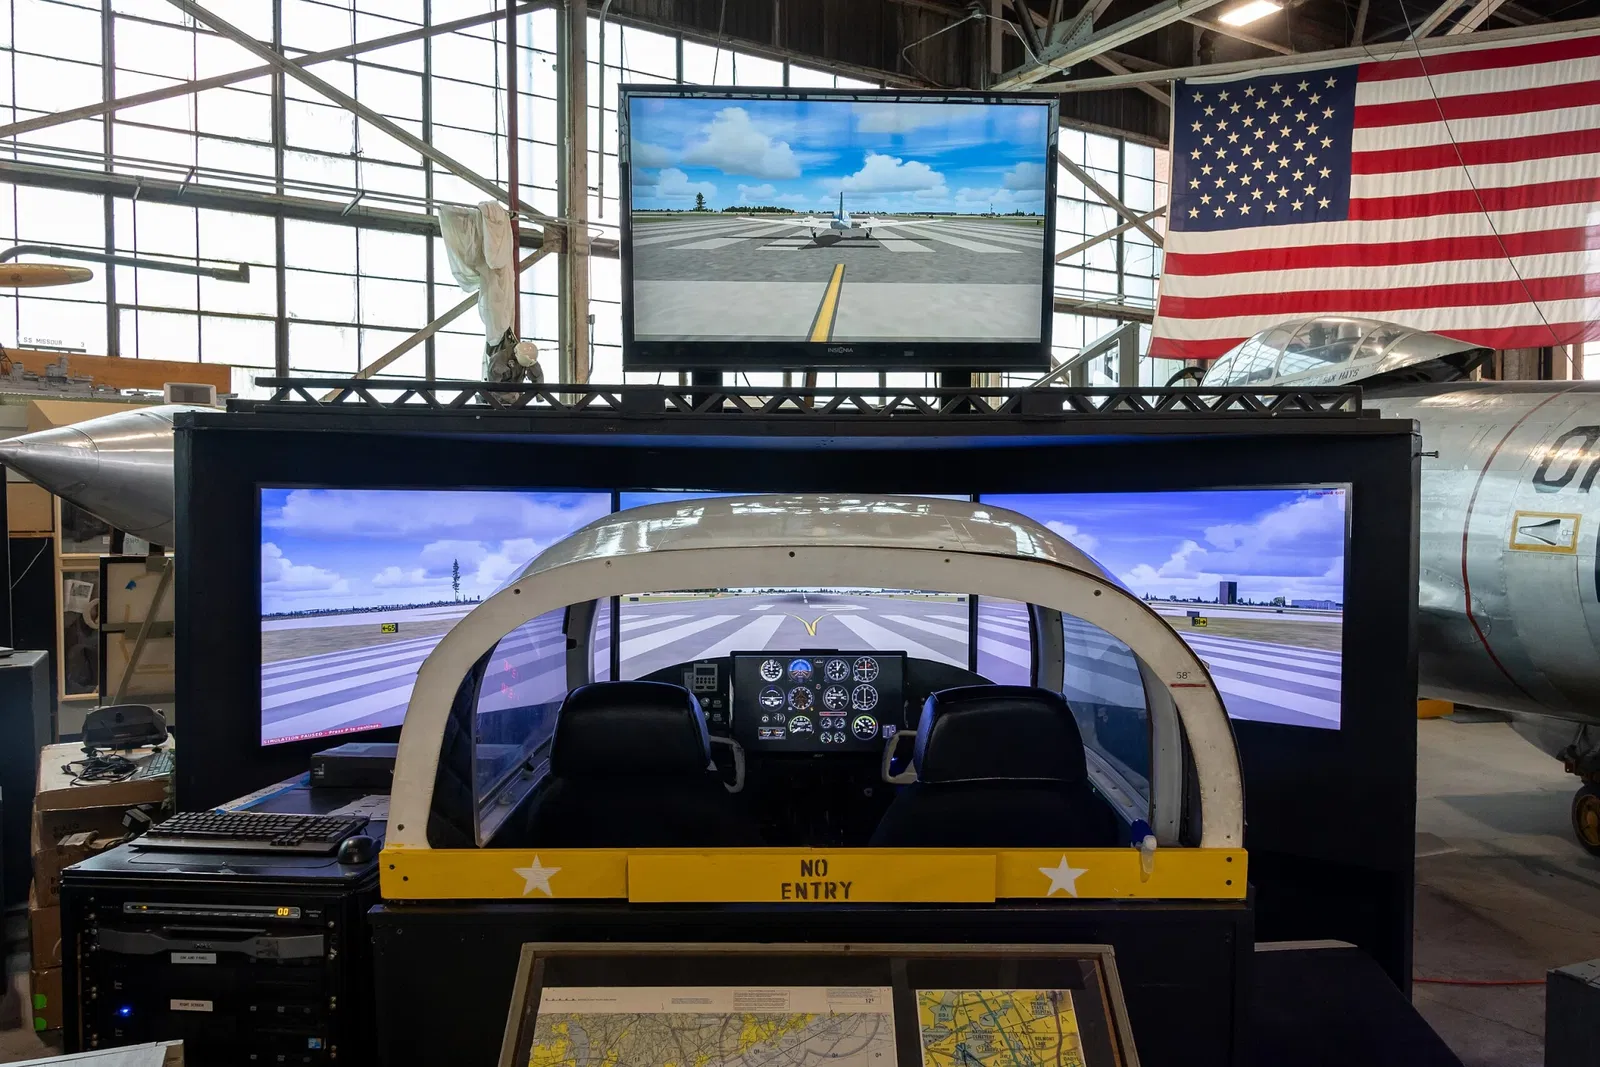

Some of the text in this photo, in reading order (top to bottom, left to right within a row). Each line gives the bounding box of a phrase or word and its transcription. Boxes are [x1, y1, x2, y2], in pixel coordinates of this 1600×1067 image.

[827, 346, 854, 354] INSIGNIA
[263, 735, 299, 744] SIMULATION
[301, 731, 323, 739] PAUSED
[801, 859, 828, 877] NO
[781, 881, 853, 900] ENTRY
[277, 907, 289, 916] 00
